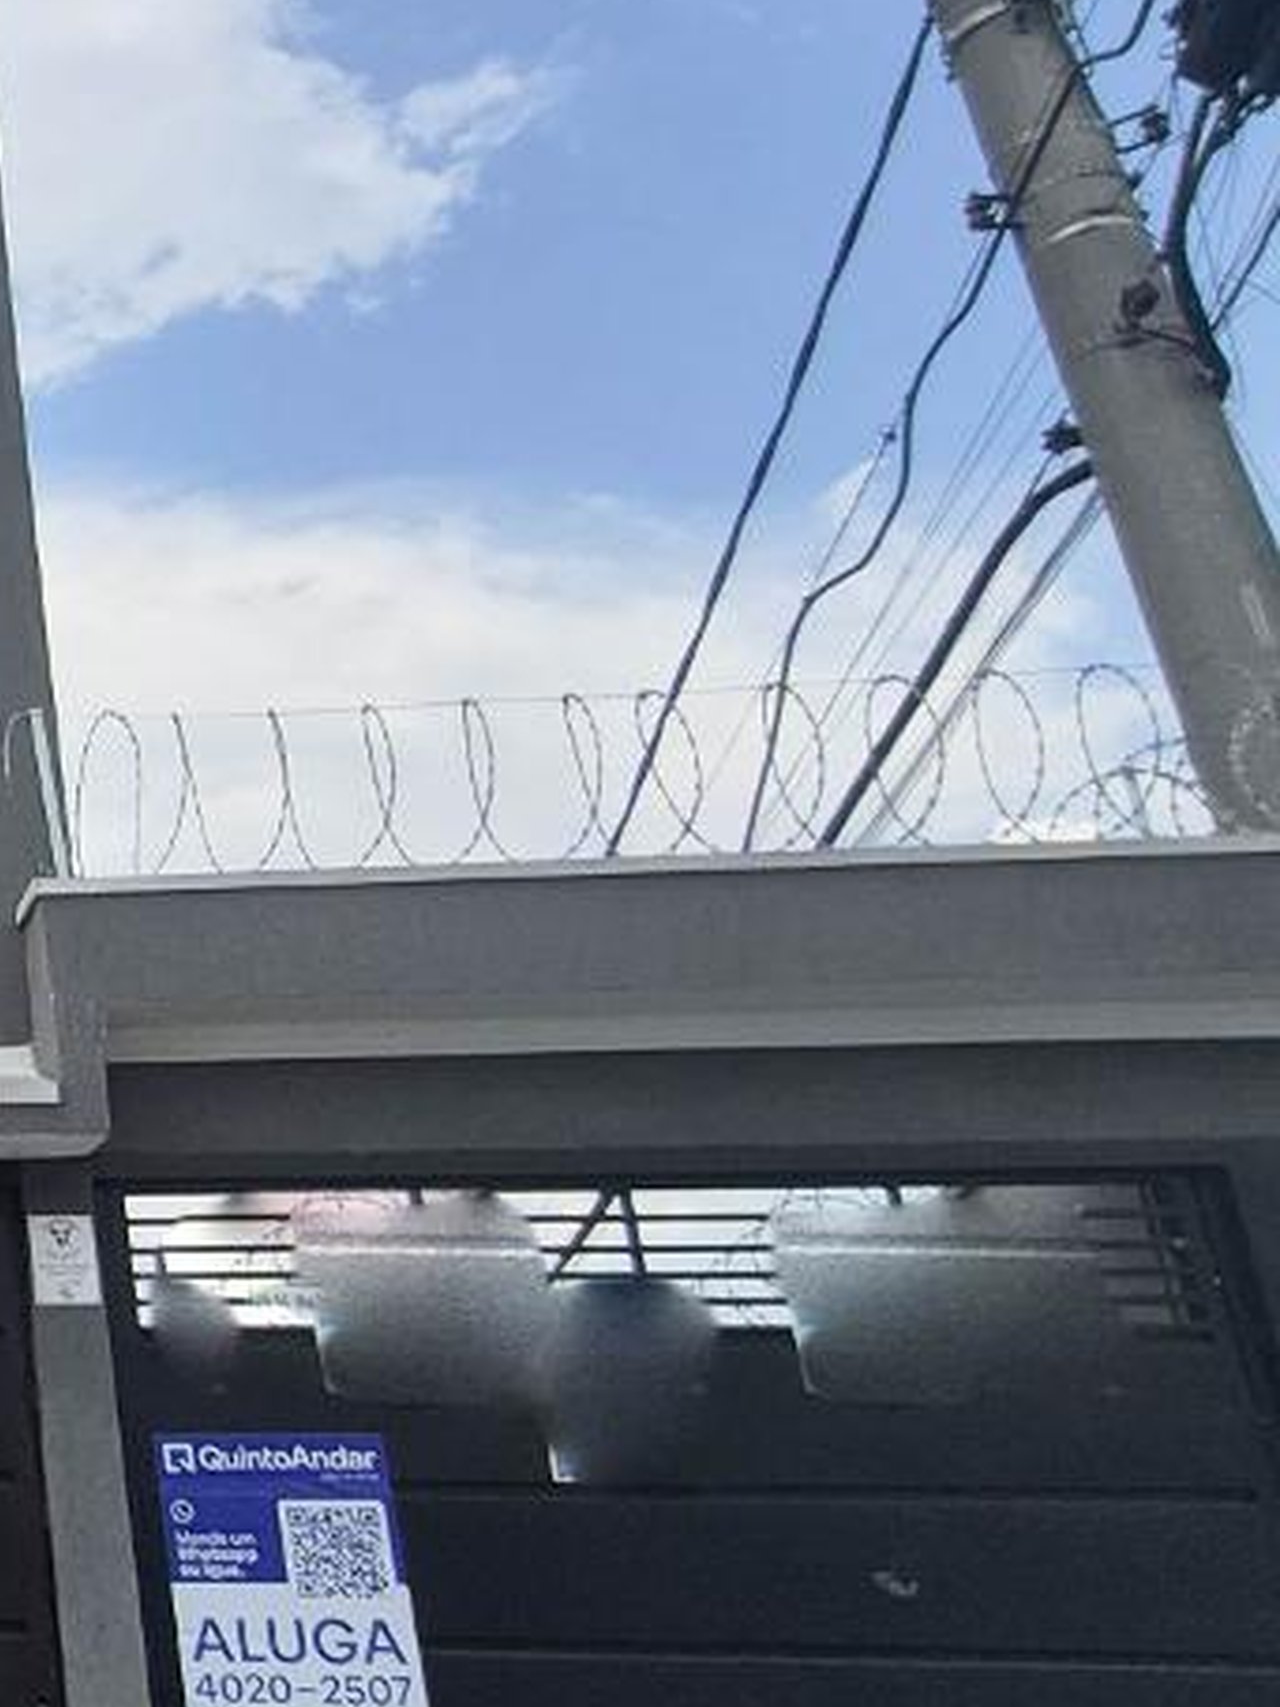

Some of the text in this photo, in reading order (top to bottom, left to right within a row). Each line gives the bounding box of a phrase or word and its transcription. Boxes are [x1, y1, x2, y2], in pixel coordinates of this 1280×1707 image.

[198, 1443, 378, 1472] QuintoAndar
[193, 1617, 408, 1665] ALUGA
[195, 1673, 411, 1706] 4020-2507
